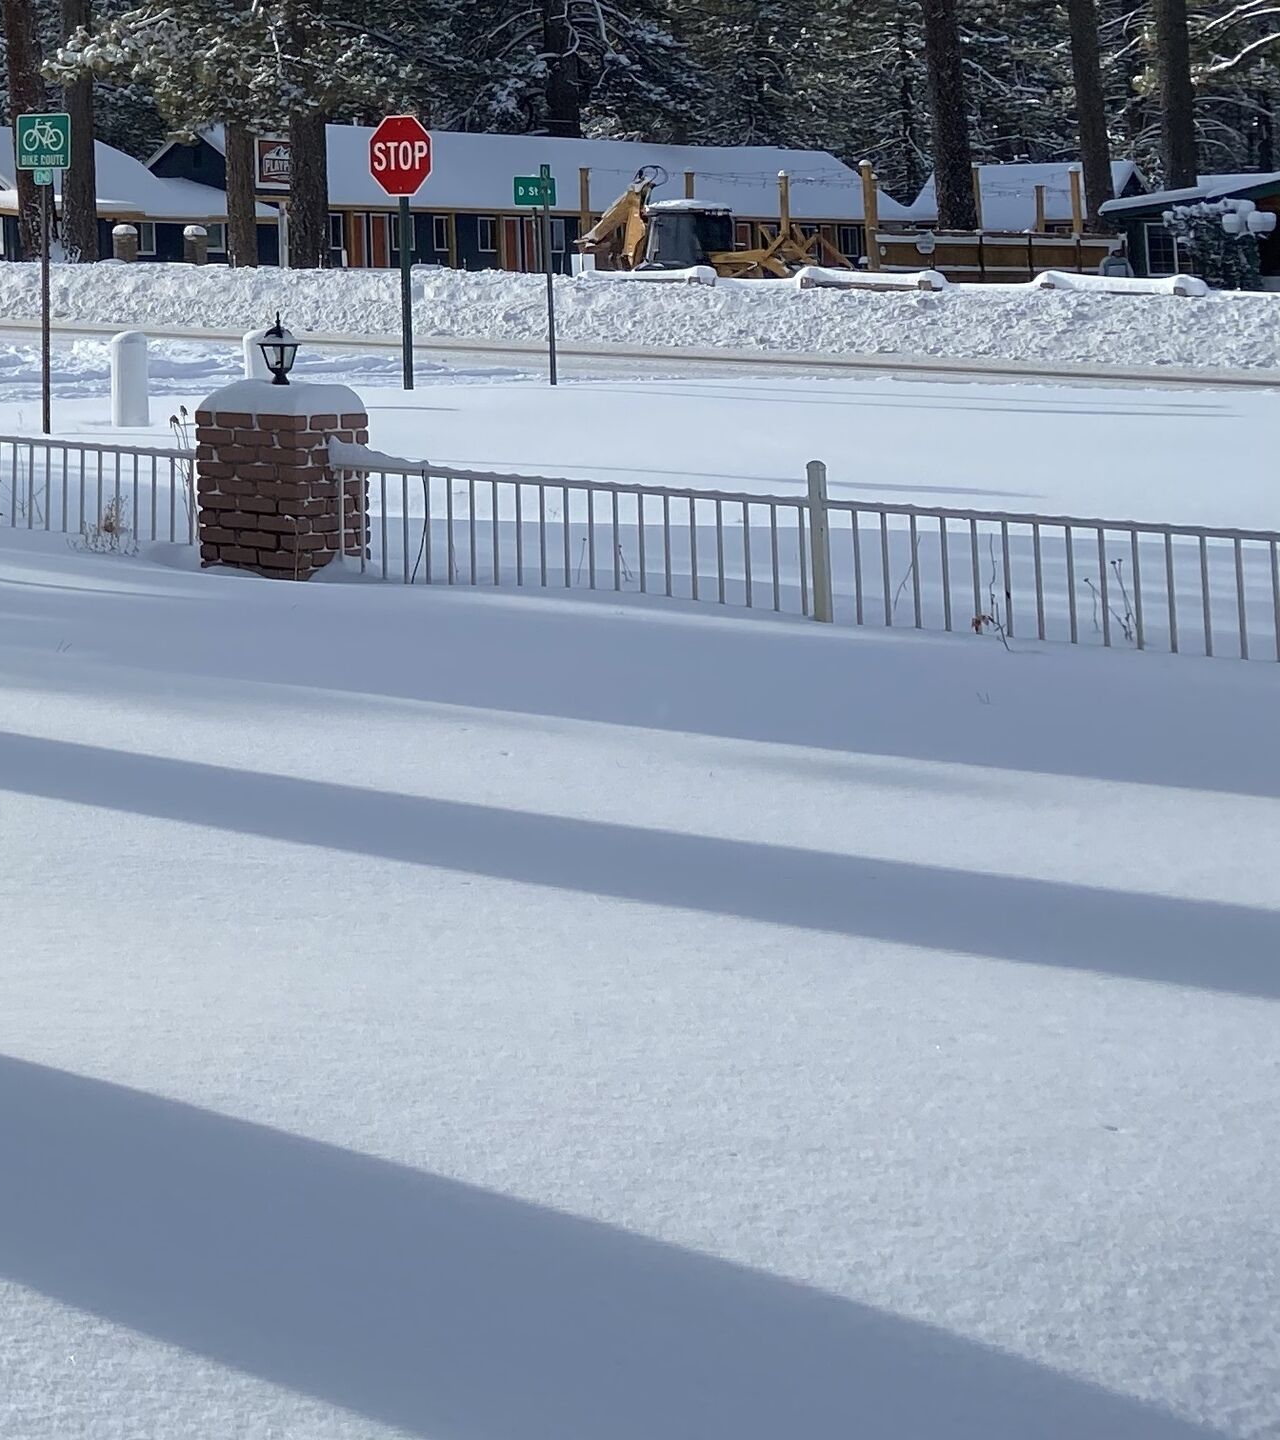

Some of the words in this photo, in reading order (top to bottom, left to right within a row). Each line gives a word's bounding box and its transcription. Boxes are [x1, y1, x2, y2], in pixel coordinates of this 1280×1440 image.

[21, 154, 39, 166] BIKE
[40, 154, 65, 166] ROUTE
[373, 140, 429, 172] STOP
[518, 185, 525, 196] D
[528, 185, 539, 196] St
